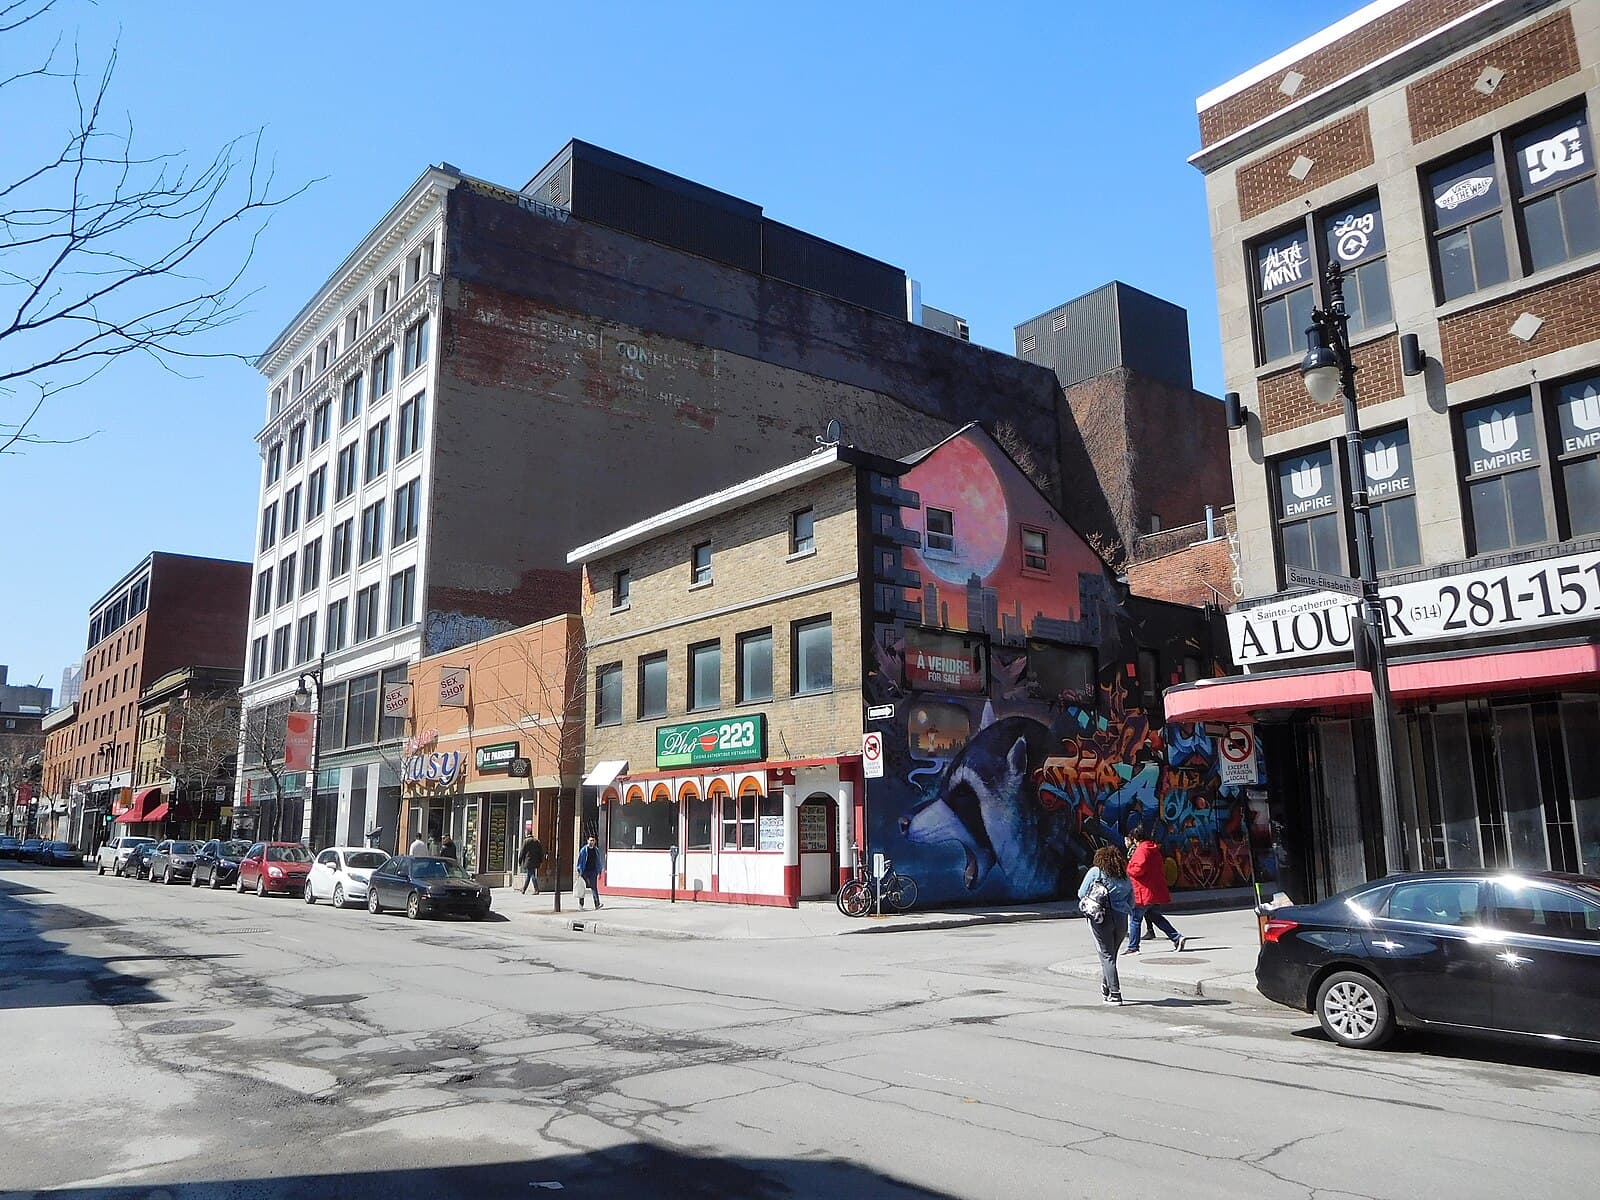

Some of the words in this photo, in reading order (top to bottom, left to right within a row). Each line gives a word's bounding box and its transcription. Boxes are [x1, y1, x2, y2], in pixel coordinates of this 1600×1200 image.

[1525, 127, 1584, 184] DC
[1451, 182, 1472, 193] VANS
[1456, 189, 1470, 200] THE
[1473, 448, 1532, 472] EMPIRE
[1367, 477, 1410, 497] MPIRE
[1286, 495, 1333, 516] EMPIRE
[1257, 597, 1338, 621] Sainte-Catherine
[1239, 615, 1269, 659] À
[1275, 594, 1413, 655] LOUR
[1410, 601, 1442, 623] (514)
[916, 650, 926, 669] À
[927, 655, 970, 674] VENDRE
[441, 676, 458, 689] SEX
[928, 671, 942, 682] FOR
[943, 674, 961, 684] SALE
[385, 691, 402, 702] SEX
[441, 683, 465, 698] SHOP
[385, 697, 409, 711] SHOP
[719, 721, 755, 749] 223
